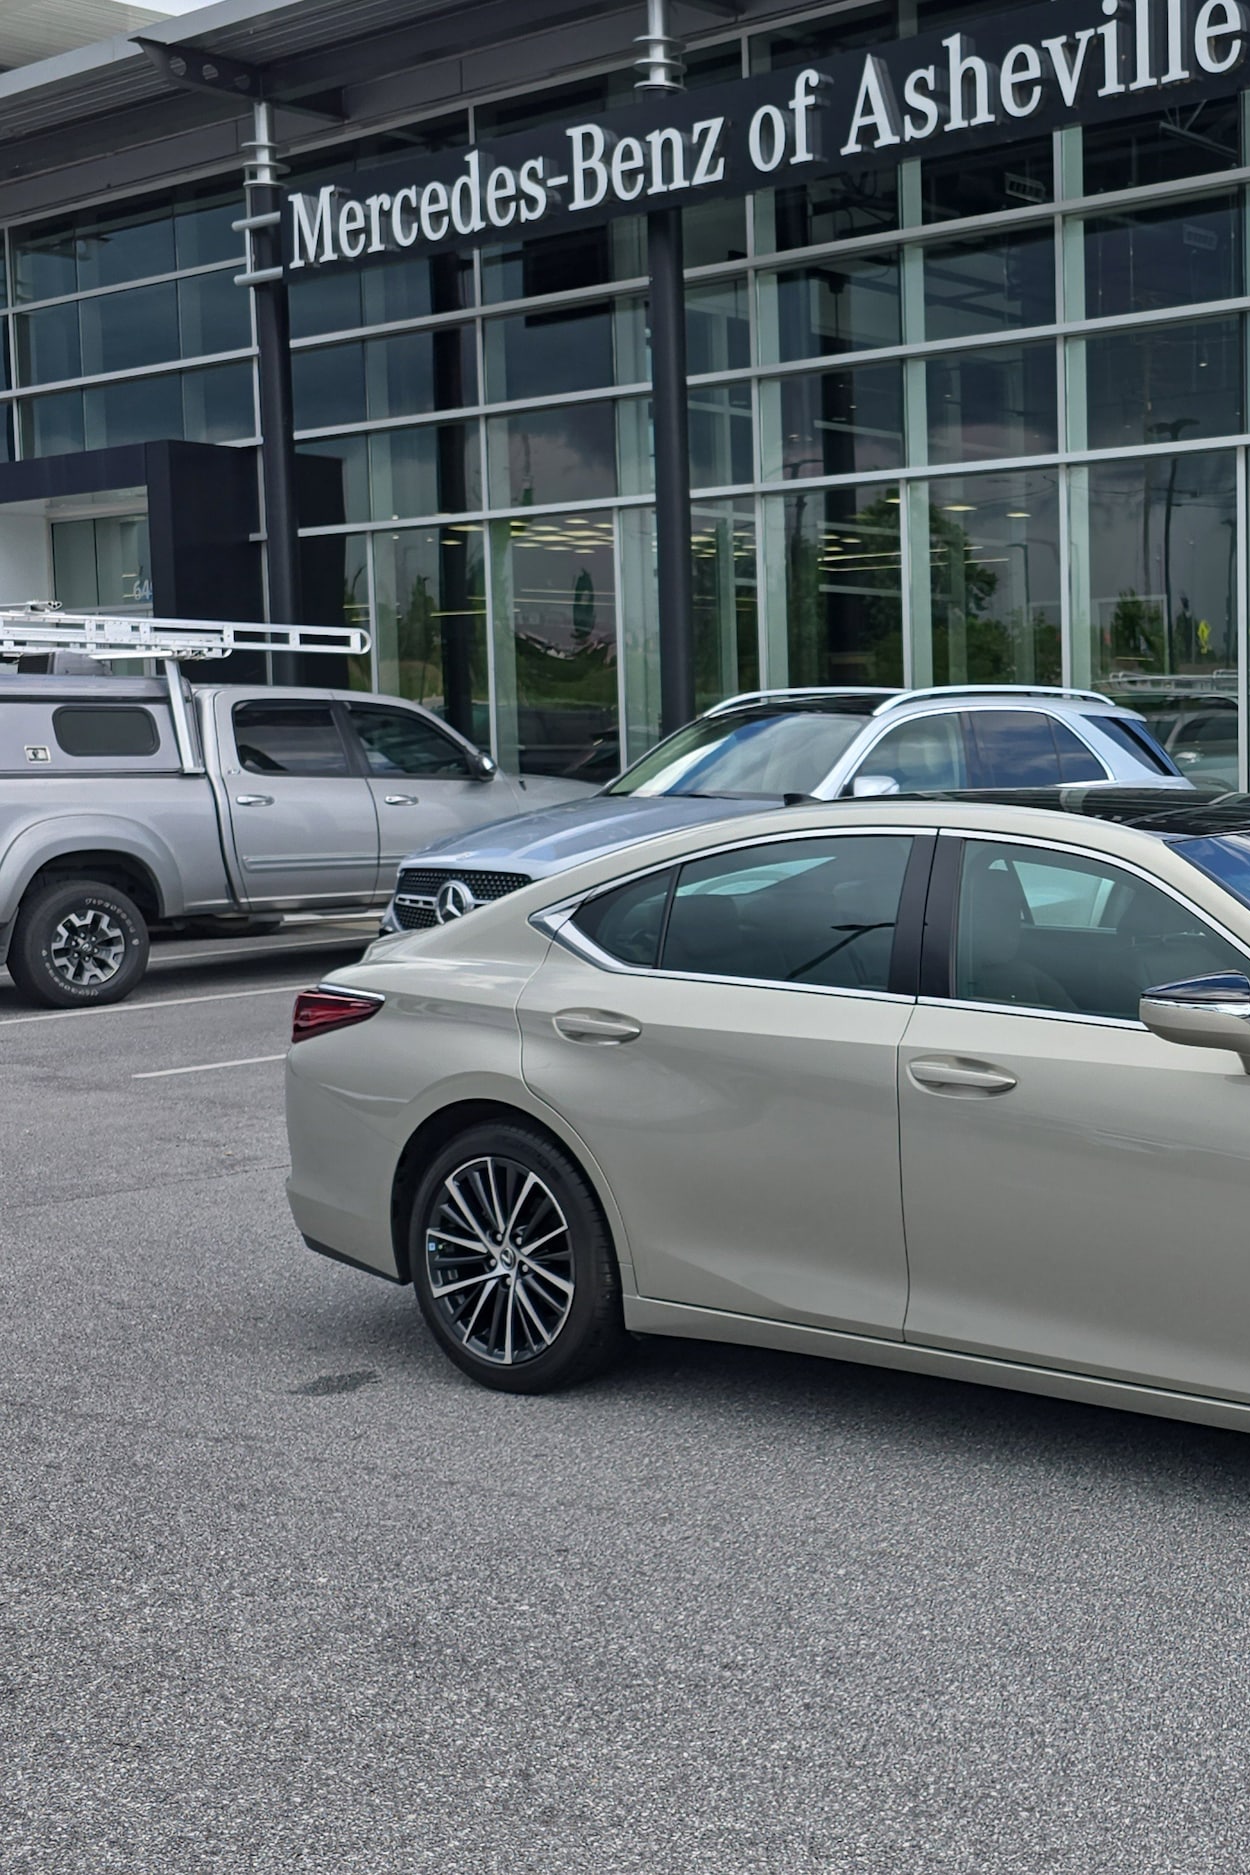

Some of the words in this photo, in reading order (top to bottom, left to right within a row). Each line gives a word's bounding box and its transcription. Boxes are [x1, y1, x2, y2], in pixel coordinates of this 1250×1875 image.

[287, 115, 726, 271] Mercedes-Benz
[748, 67, 819, 173] of
[840, 0, 1243, 156] Asheville
